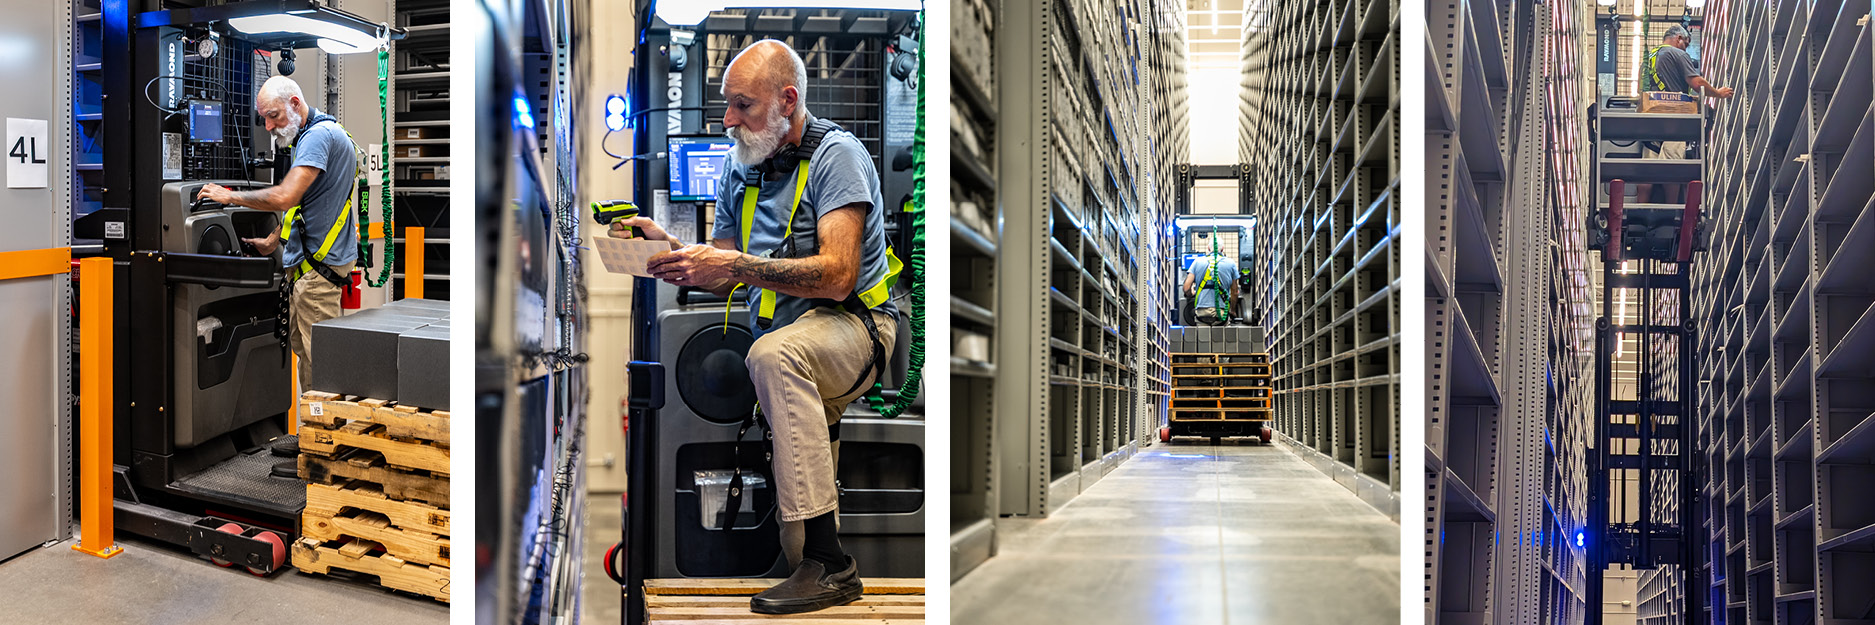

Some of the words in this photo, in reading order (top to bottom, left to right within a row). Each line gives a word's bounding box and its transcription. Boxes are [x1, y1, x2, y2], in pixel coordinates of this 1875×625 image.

[168, 42, 176, 108] RAYMOND
[668, 72, 682, 134] AYMON
[1660, 93, 1682, 101] ULINE
[9, 136, 46, 164] 4L
[371, 155, 382, 171] 5L
